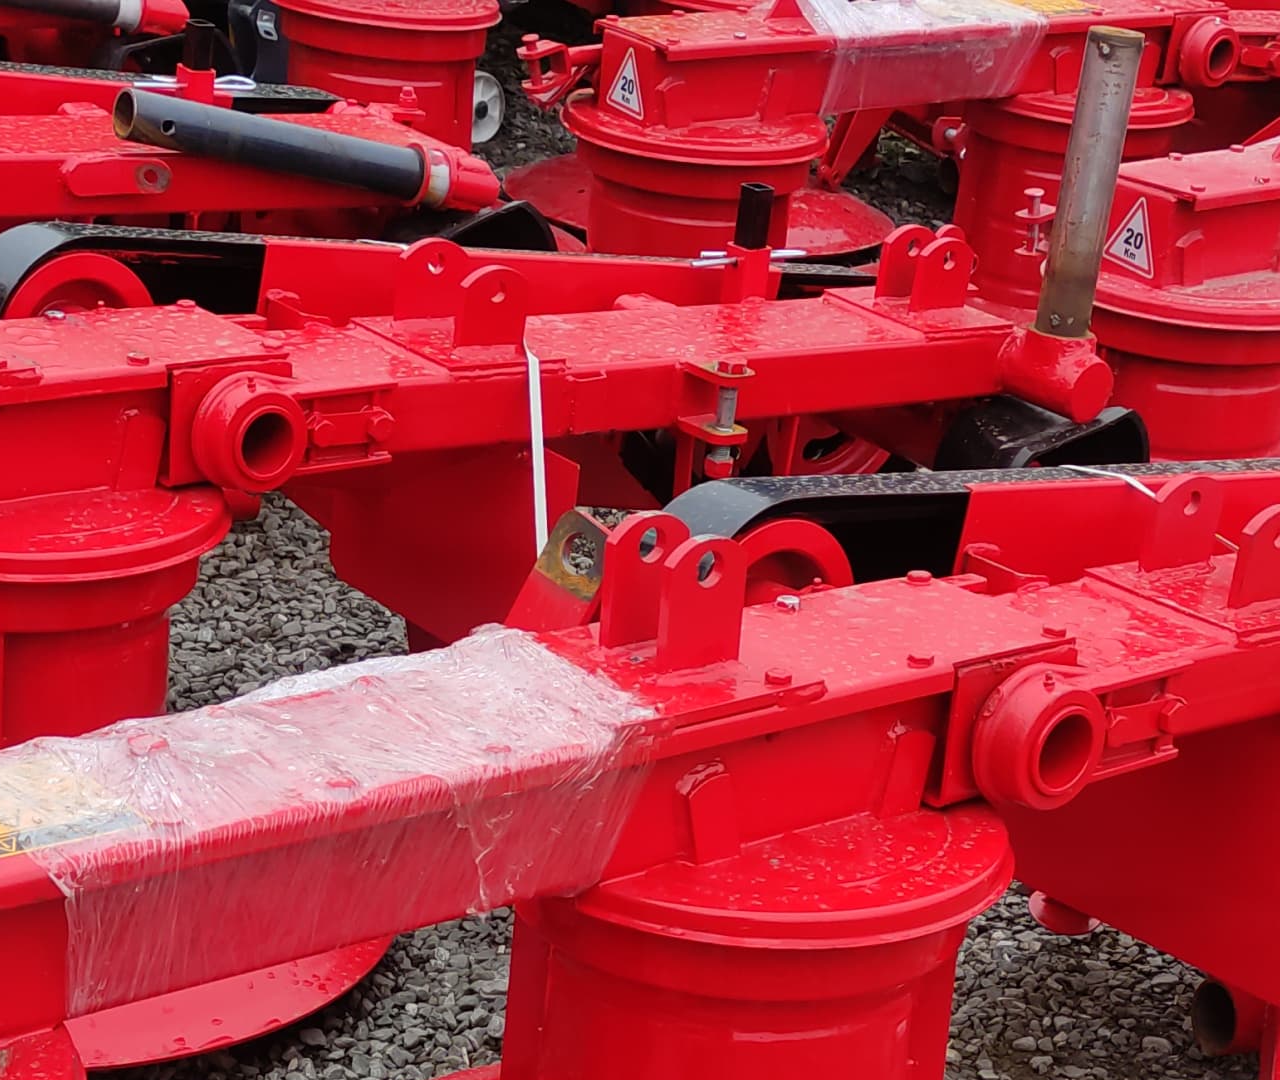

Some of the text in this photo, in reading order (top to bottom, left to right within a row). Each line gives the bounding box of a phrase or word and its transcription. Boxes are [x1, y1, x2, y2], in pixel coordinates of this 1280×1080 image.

[621, 76, 634, 95] 20
[1124, 228, 1143, 250] 20
[1124, 248, 1136, 260] Km
